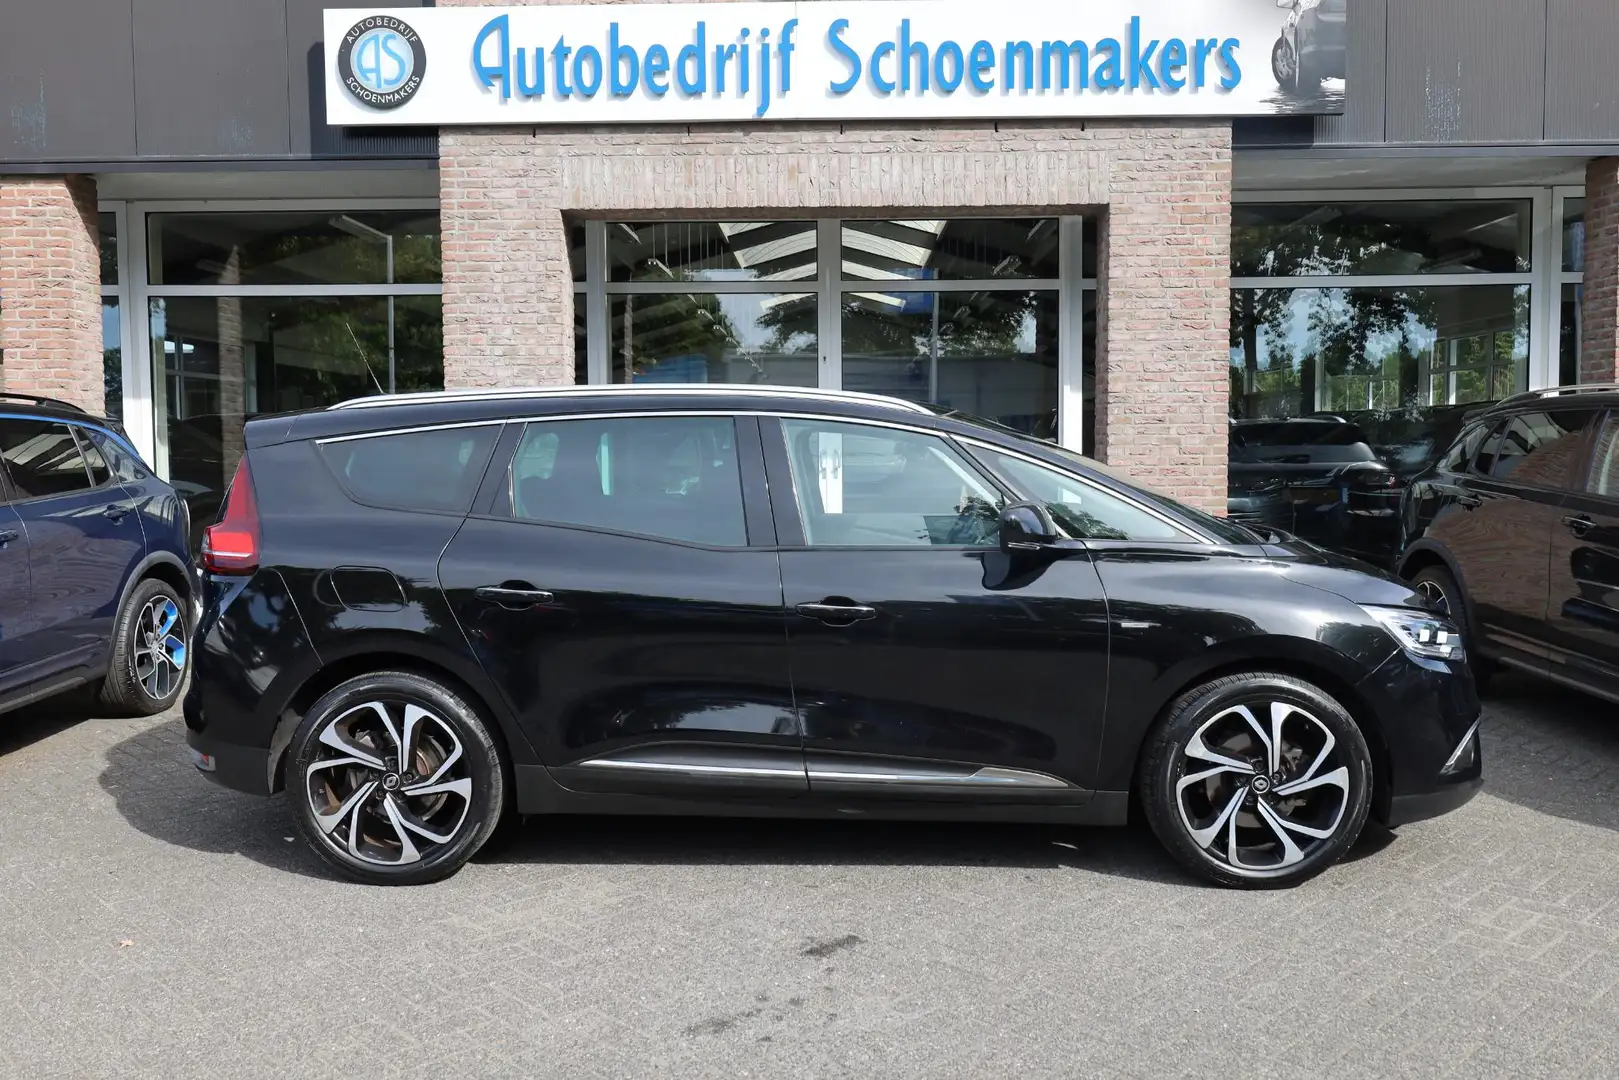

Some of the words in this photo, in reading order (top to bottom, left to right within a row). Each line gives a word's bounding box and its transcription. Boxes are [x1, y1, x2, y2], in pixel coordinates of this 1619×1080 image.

[346, 17, 418, 44] AUTOBEDRIJF
[356, 33, 406, 88] AS
[473, 14, 798, 118] Autobedrijf
[827, 16, 1242, 93] Schoenmakers
[346, 75, 420, 103] SCHOENMAKERS
